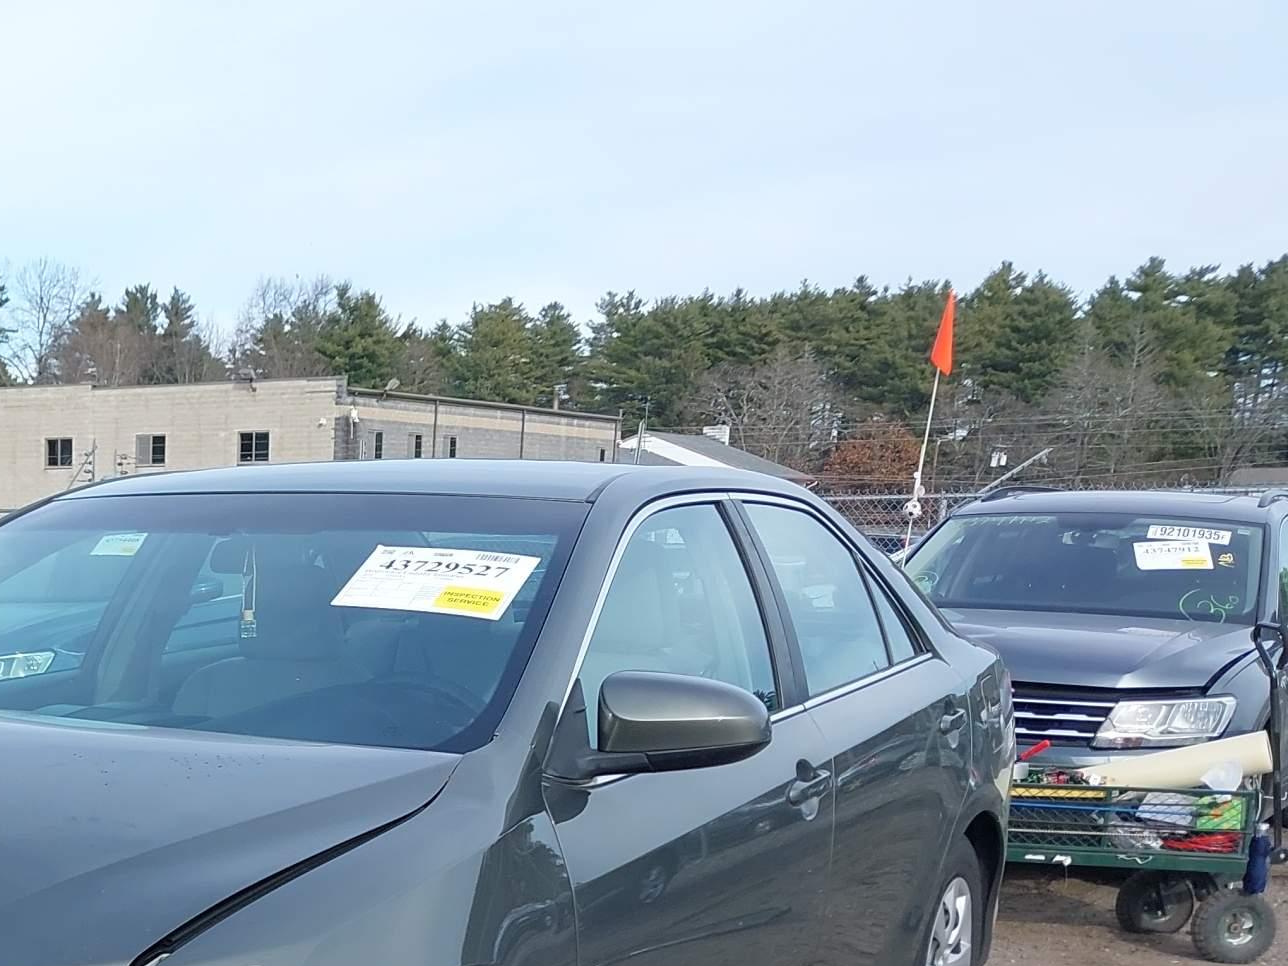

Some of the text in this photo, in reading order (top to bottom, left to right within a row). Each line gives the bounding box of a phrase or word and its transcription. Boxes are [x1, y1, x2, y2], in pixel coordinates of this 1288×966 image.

[378, 558, 511, 578] 43729527
[443, 590, 501, 603] INSPECTION
[446, 597, 490, 608] SERVICE
